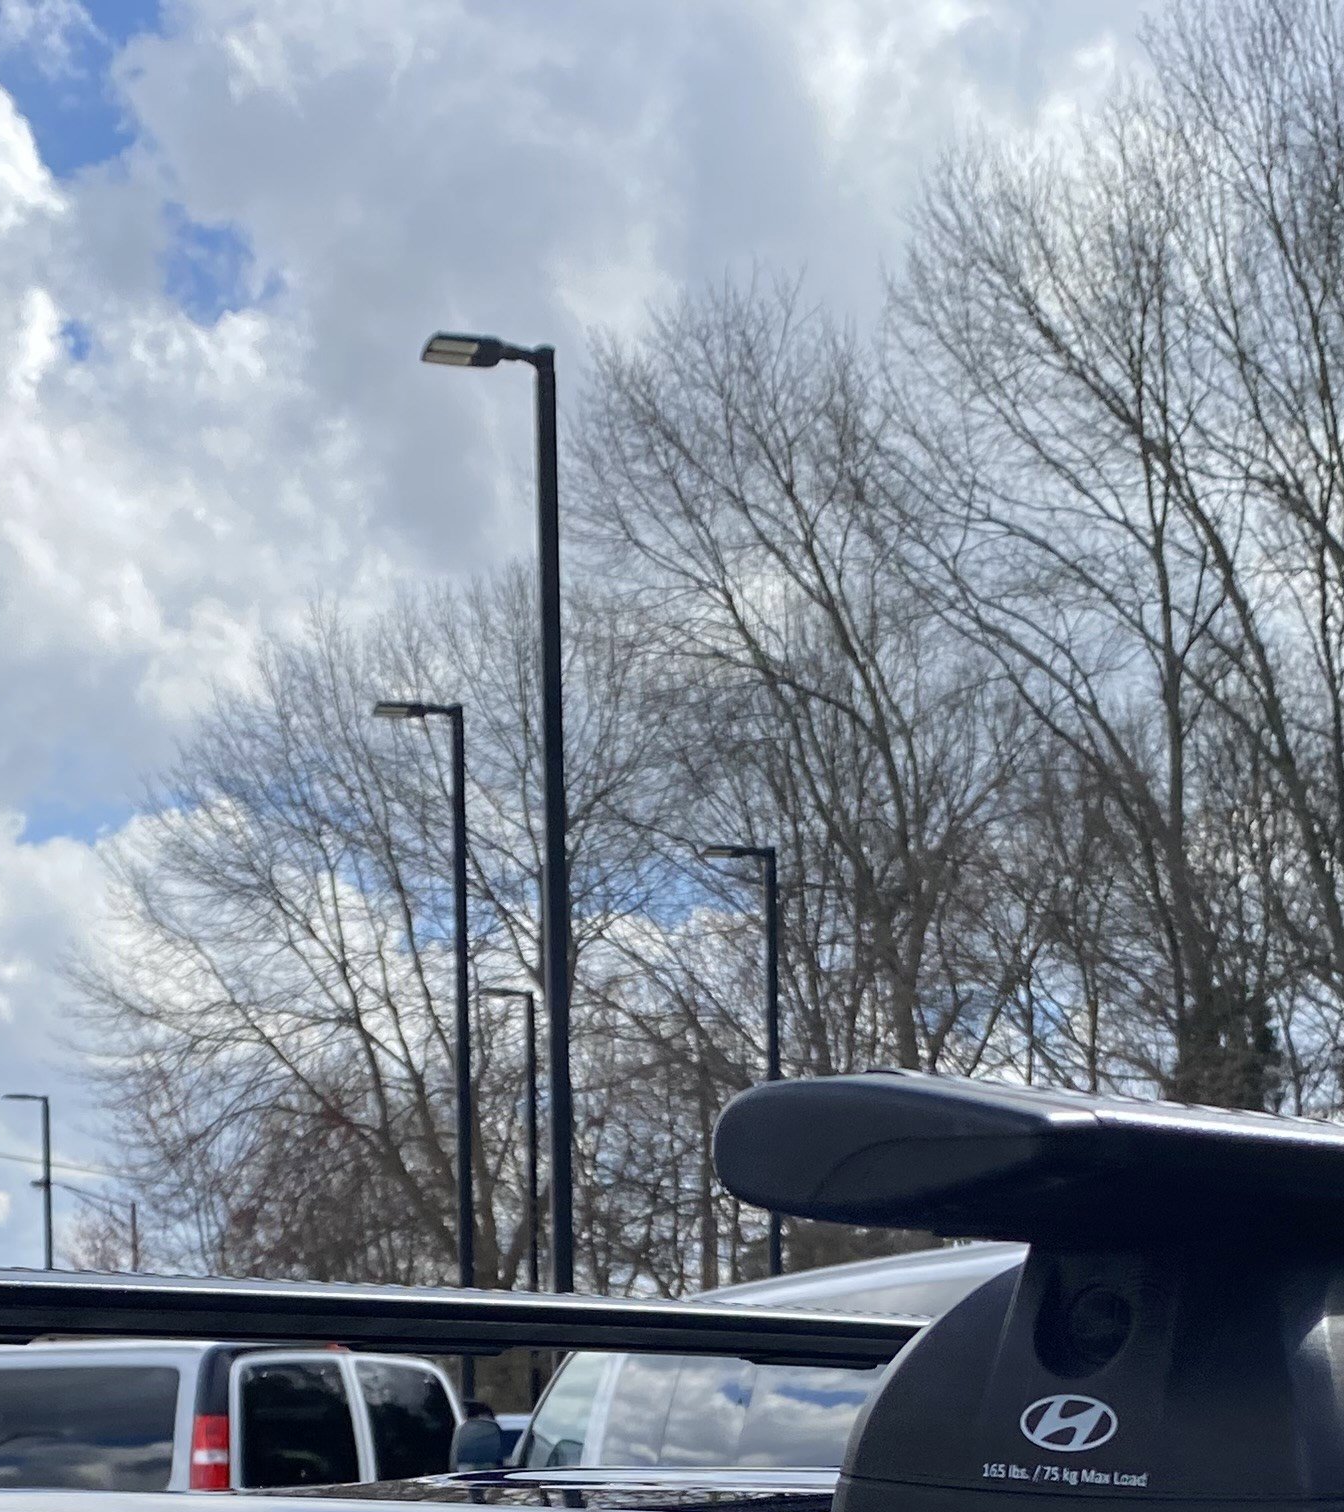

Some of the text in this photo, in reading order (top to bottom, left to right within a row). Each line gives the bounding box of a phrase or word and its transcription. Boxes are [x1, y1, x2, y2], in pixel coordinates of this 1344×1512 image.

[982, 1463, 1006, 1478] 165
[1008, 1464, 1029, 1479] lbs.
[1043, 1465, 1059, 1481] 75
[1062, 1466, 1079, 1486] kg
[1081, 1469, 1110, 1485] Max
[1113, 1471, 1148, 1488] Load
